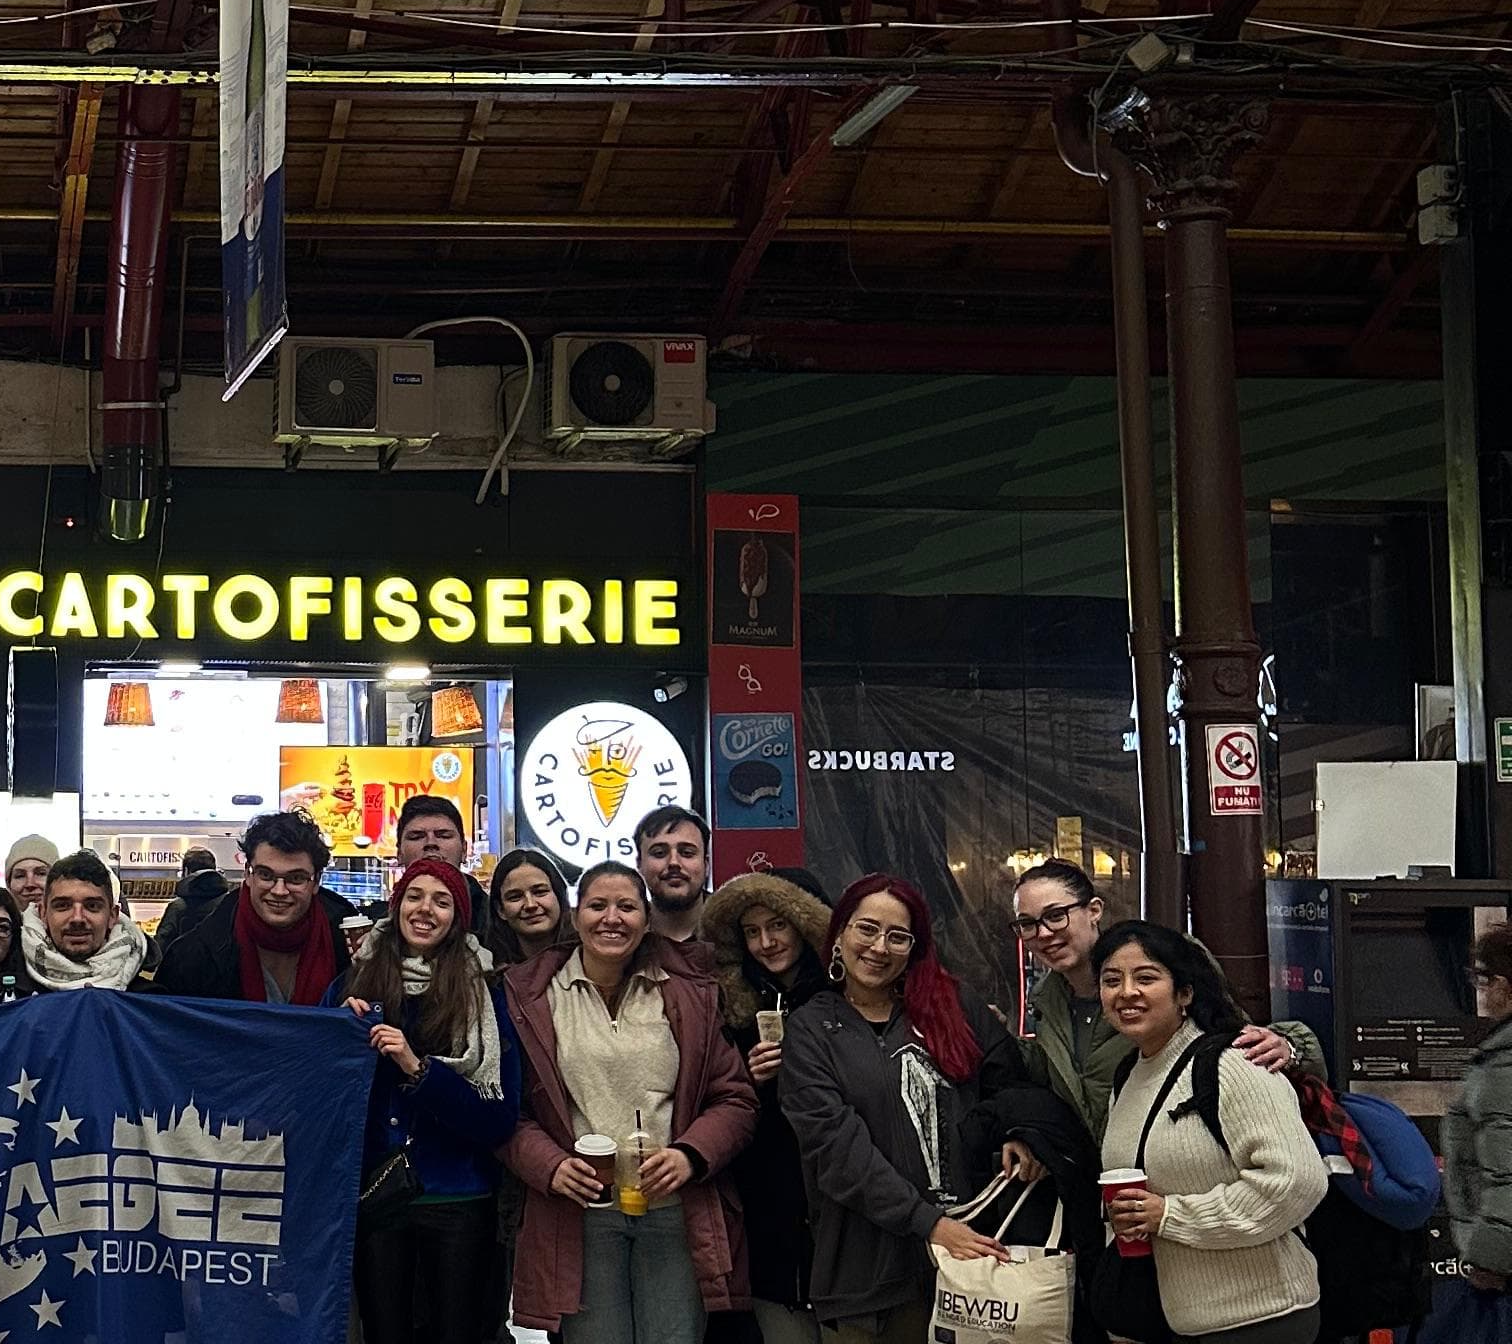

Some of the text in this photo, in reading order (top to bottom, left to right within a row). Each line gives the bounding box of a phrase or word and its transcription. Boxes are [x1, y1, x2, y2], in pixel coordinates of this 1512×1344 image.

[729, 624, 777, 637] MAGNUM
[719, 717, 792, 760] Cornetto
[762, 743, 788, 757] GO!
[1234, 786, 1250, 795] NU
[0, 1153, 286, 1246] AEGEE
[102, 1239, 278, 1286] BUDAPEST
